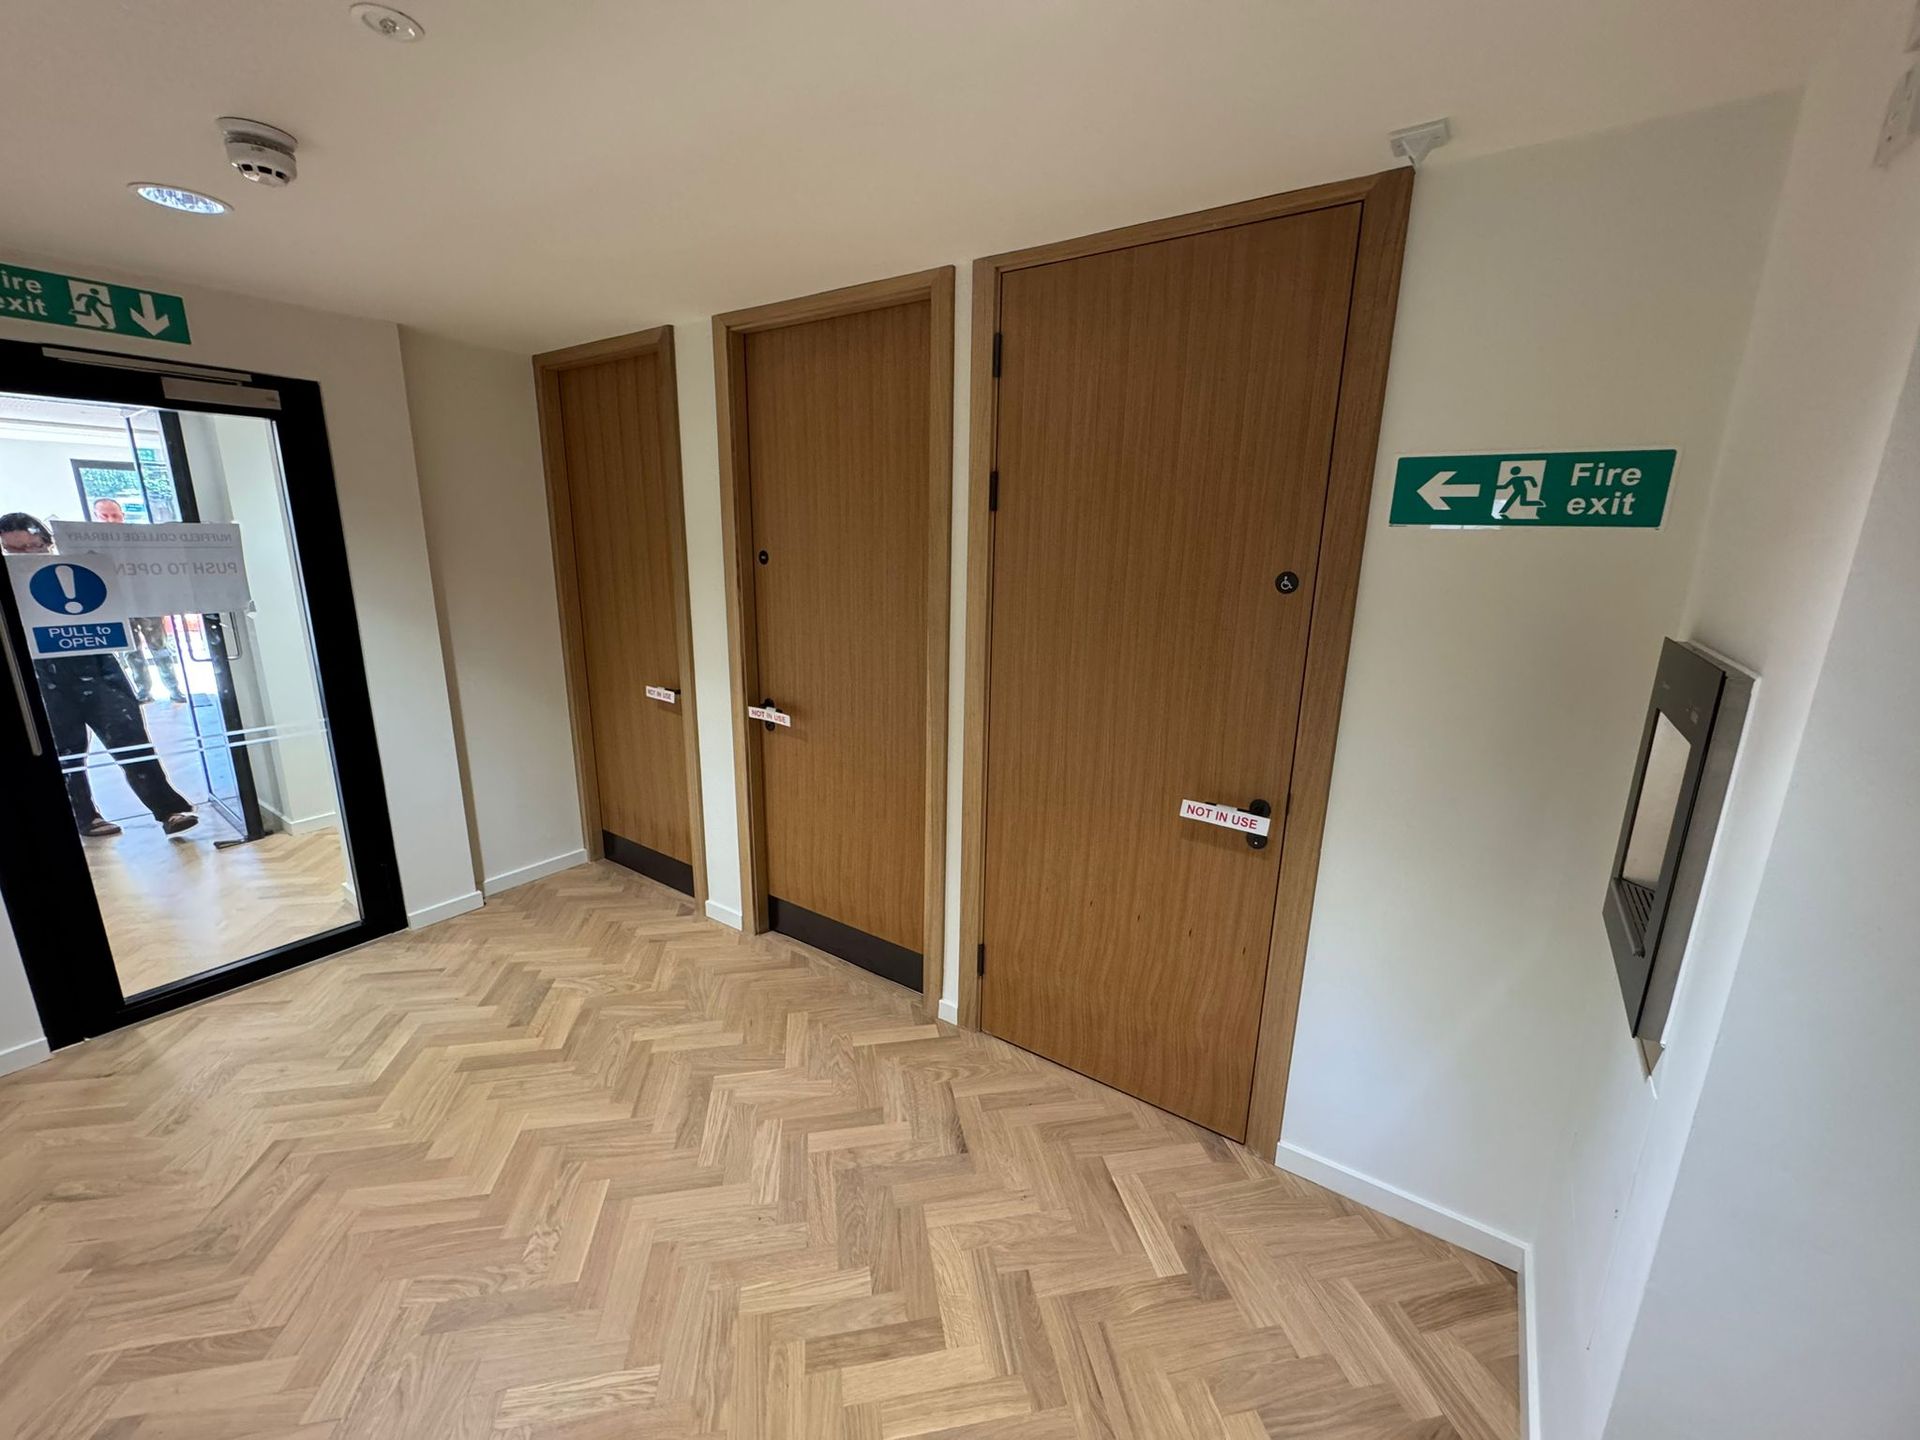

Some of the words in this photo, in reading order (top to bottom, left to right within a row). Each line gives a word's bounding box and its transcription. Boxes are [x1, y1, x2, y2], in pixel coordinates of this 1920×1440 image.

[0, 270, 43, 293] ire
[1570, 462, 1643, 487] Fire
[1566, 491, 1636, 516] exit
[48, 626, 93, 638] PULL
[96, 625, 111, 635] to
[58, 636, 108, 649] OPEN
[647, 688, 656, 697] NOT
[751, 709, 765, 718] NOT
[766, 711, 772, 719] IN
[774, 713, 786, 724] USE
[1186, 804, 1212, 818] NOT
[1215, 811, 1228, 822] IN
[1231, 815, 1258, 830] USE
